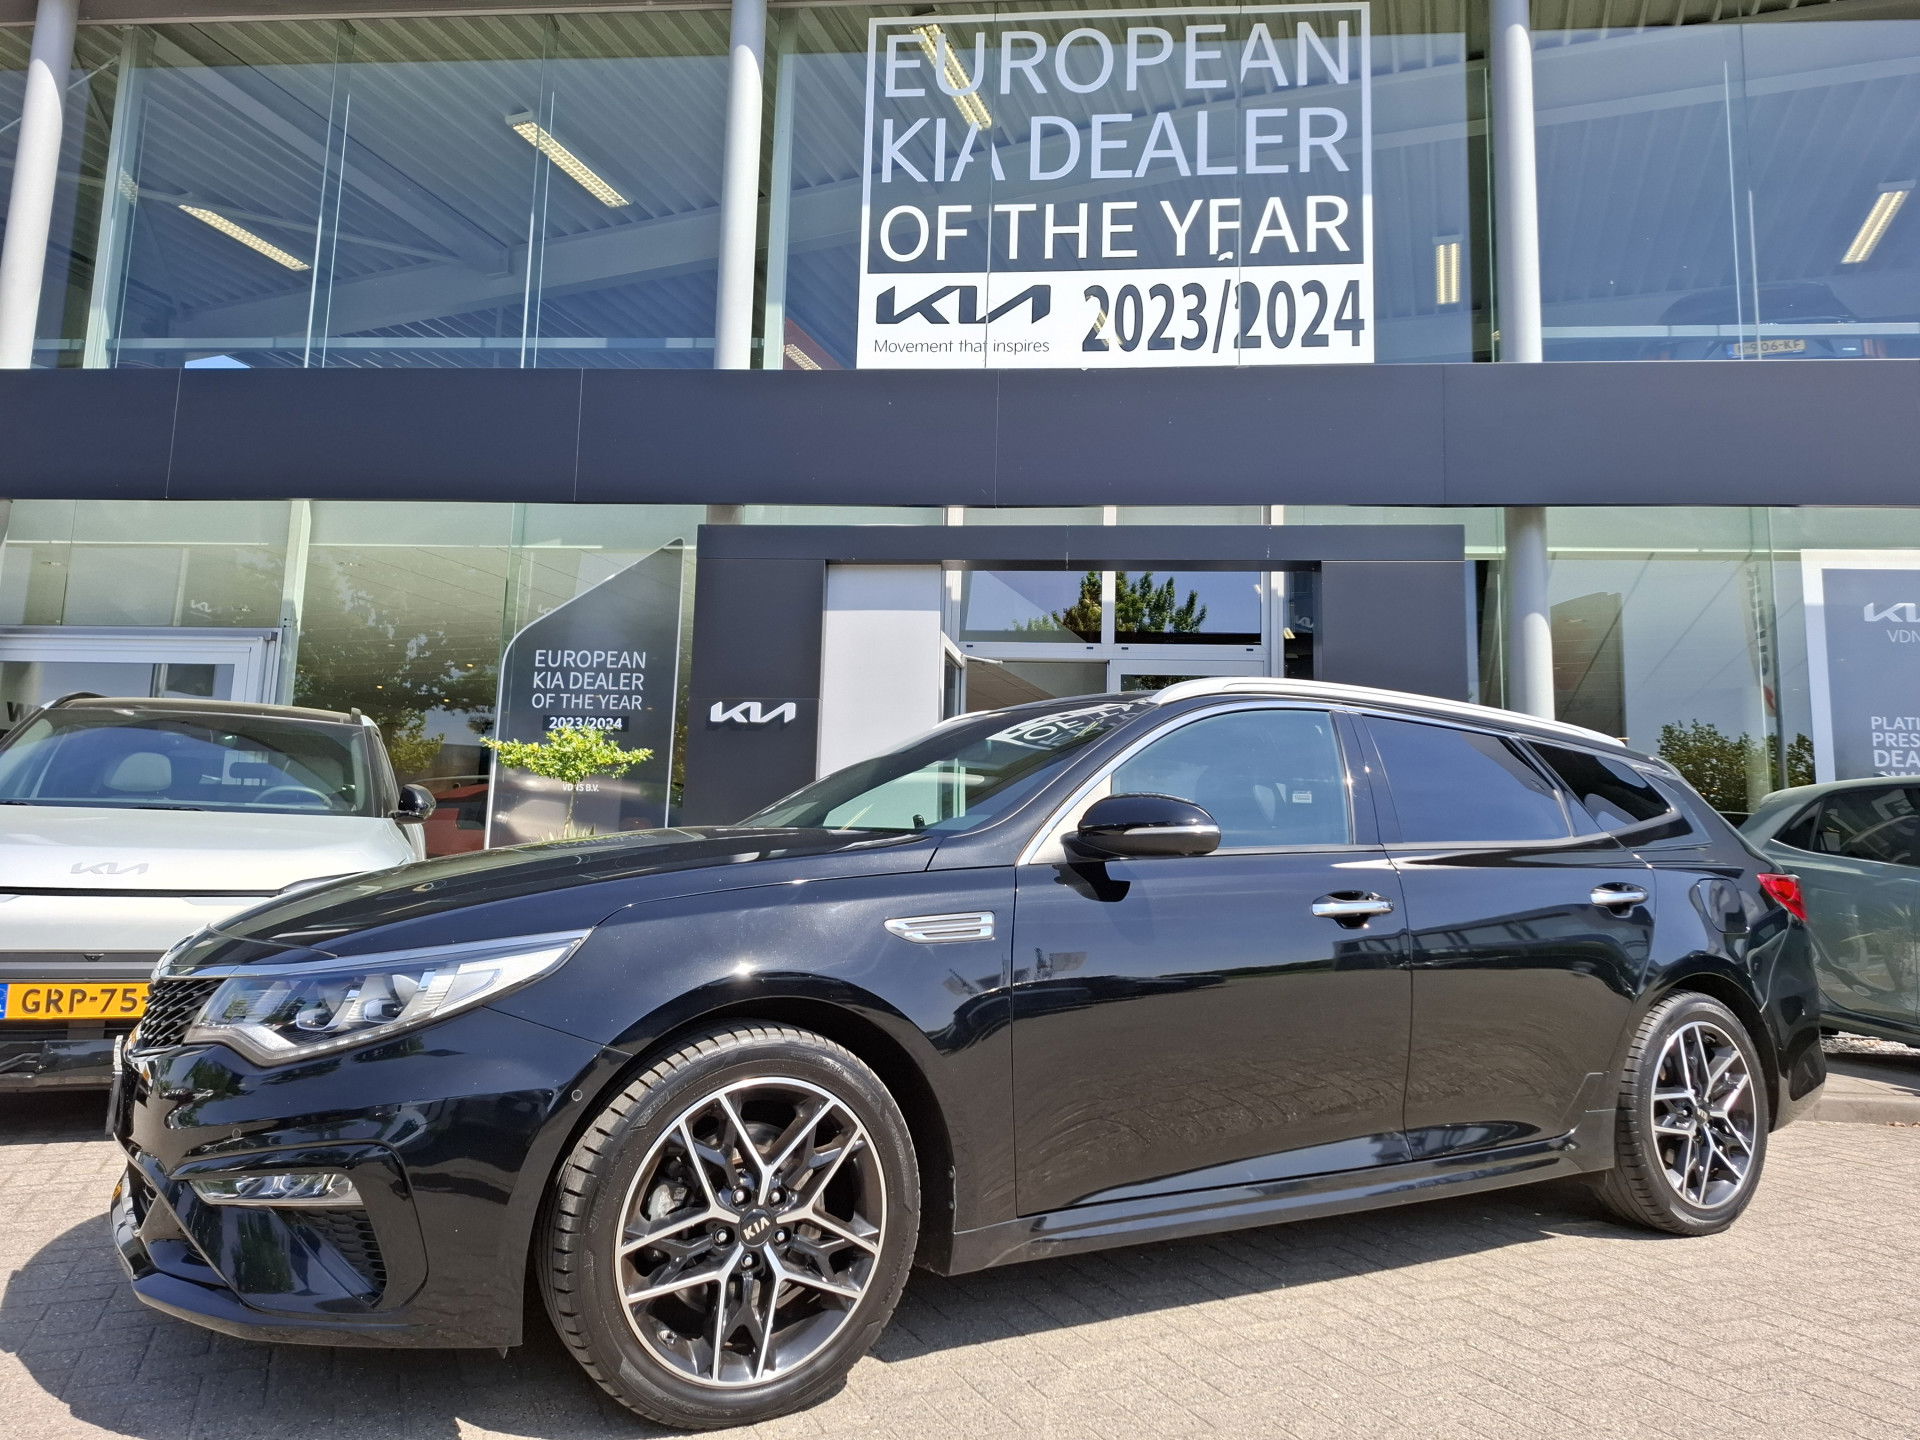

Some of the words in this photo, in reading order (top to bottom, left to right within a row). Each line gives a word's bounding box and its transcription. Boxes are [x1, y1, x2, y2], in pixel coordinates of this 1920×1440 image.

[885, 20, 1349, 97] EUROPEAN
[881, 117, 1006, 183] KIA
[1029, 107, 1350, 182] DEALER
[879, 204, 973, 263] OF
[994, 201, 1138, 260] THE
[1160, 195, 1351, 259] YEAR
[876, 285, 1051, 325] KIA
[1081, 279, 1365, 353] 2023/2024
[874, 339, 953, 353] Movement
[958, 339, 988, 353] that
[993, 339, 1050, 355] inspires
[535, 650, 646, 669] EUROPEAN
[533, 671, 565, 689] KIA
[569, 672, 644, 690] DEALER
[531, 693, 556, 709] OF
[560, 693, 594, 709] THE
[599, 694, 642, 710] YEAR
[710, 701, 796, 723] KIA
[548, 716, 623, 730] 2023/2024
[70, 862, 149, 875] KIA
[21, 988, 150, 1014] GRP-75-
[743, 1216, 770, 1240] KIA
